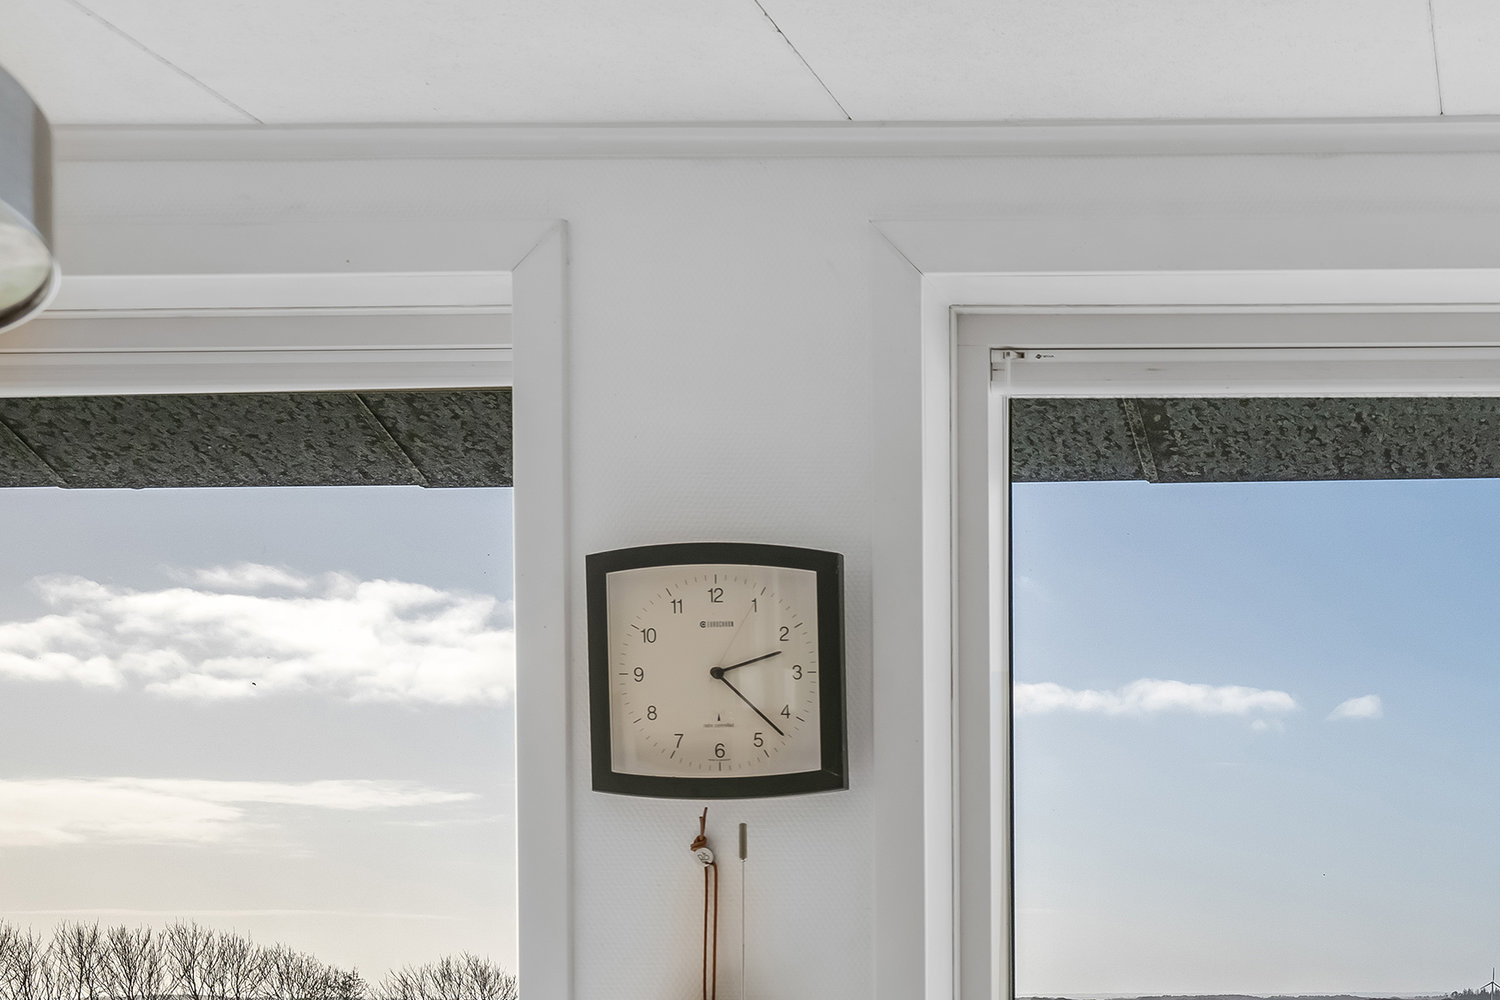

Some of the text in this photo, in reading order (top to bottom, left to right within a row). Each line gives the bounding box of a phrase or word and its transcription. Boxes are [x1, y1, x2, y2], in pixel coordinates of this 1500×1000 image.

[708, 588, 723, 603] 12
[671, 599, 683, 614] 11
[751, 598, 757, 613] 1
[640, 628, 656, 643] 10
[780, 626, 789, 642] 2
[634, 667, 644, 682] 9
[792, 665, 803, 680] 3
[647, 705, 657, 720] 8
[780, 705, 790, 719] 4
[674, 734, 684, 748] 7
[754, 732, 764, 747] 5
[715, 743, 725, 758] 6
